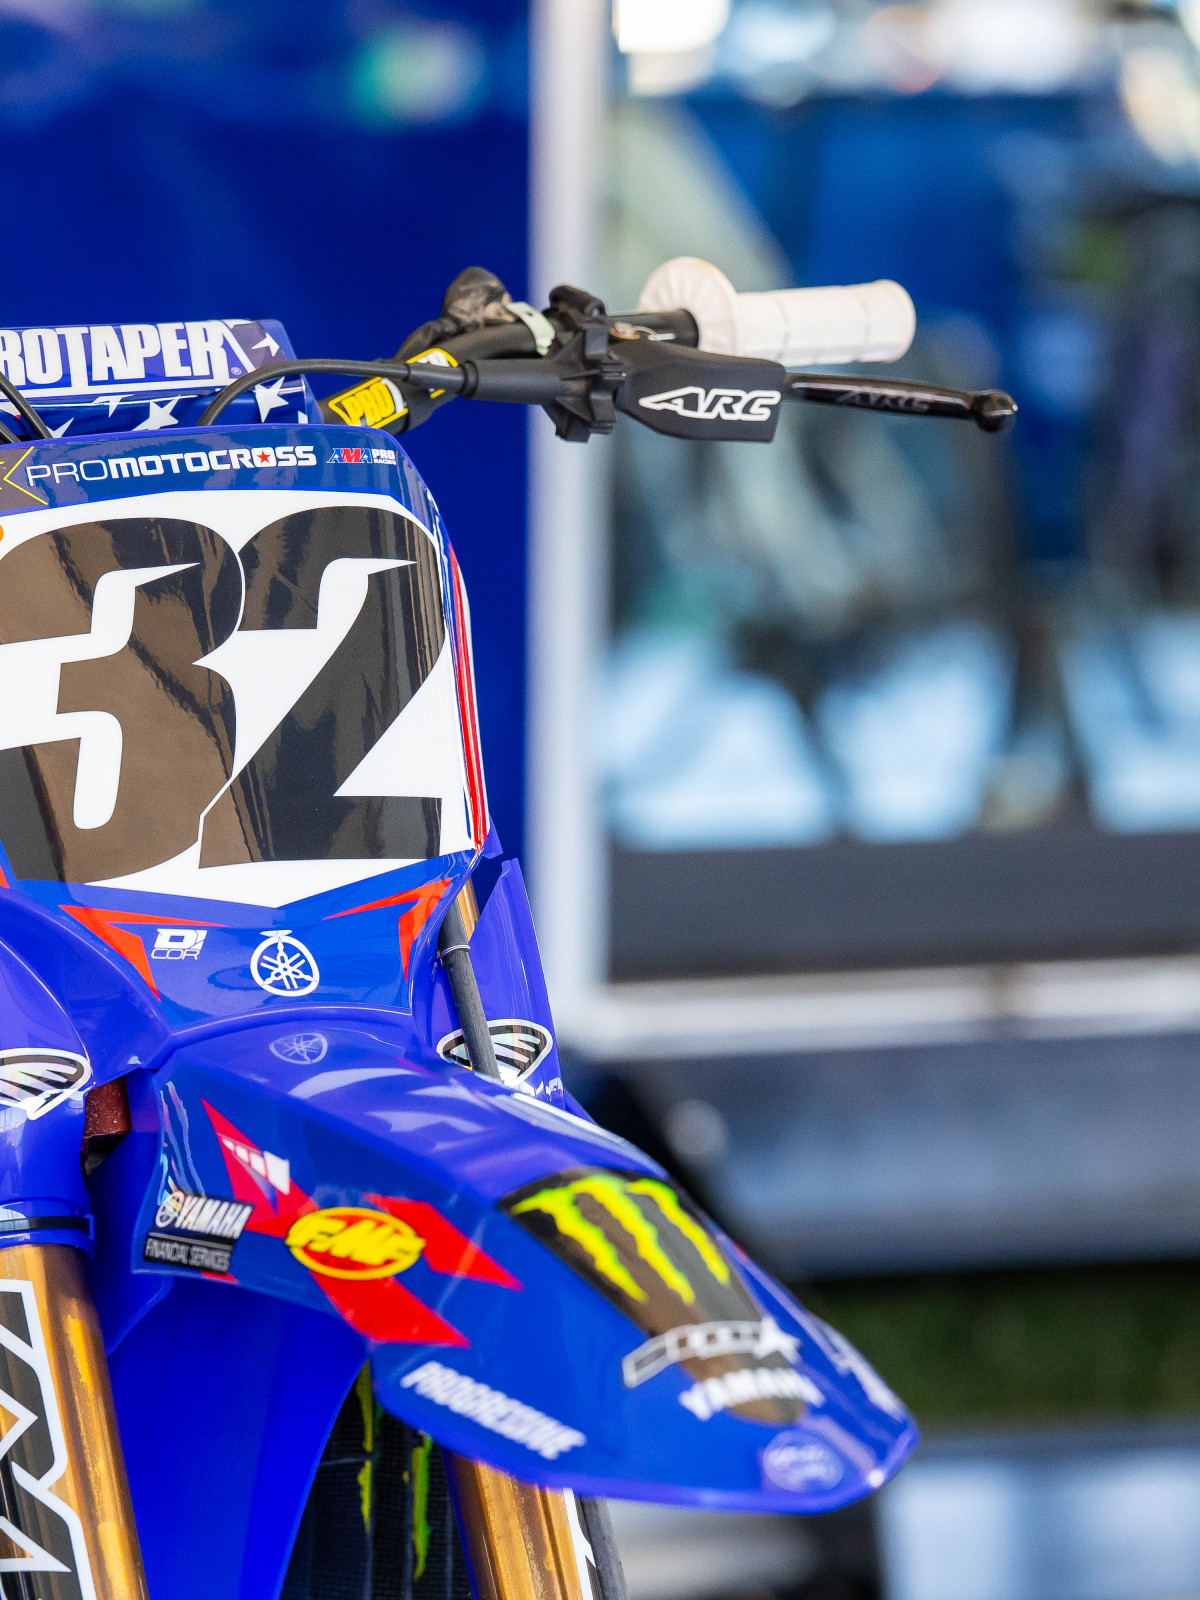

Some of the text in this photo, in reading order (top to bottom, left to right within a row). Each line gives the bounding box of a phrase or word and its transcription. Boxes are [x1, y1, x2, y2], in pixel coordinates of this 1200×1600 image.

[638, 386, 781, 421] ARC
[326, 448, 396, 464] AMA PRO
[174, 1195, 253, 1240] YAMAHA
